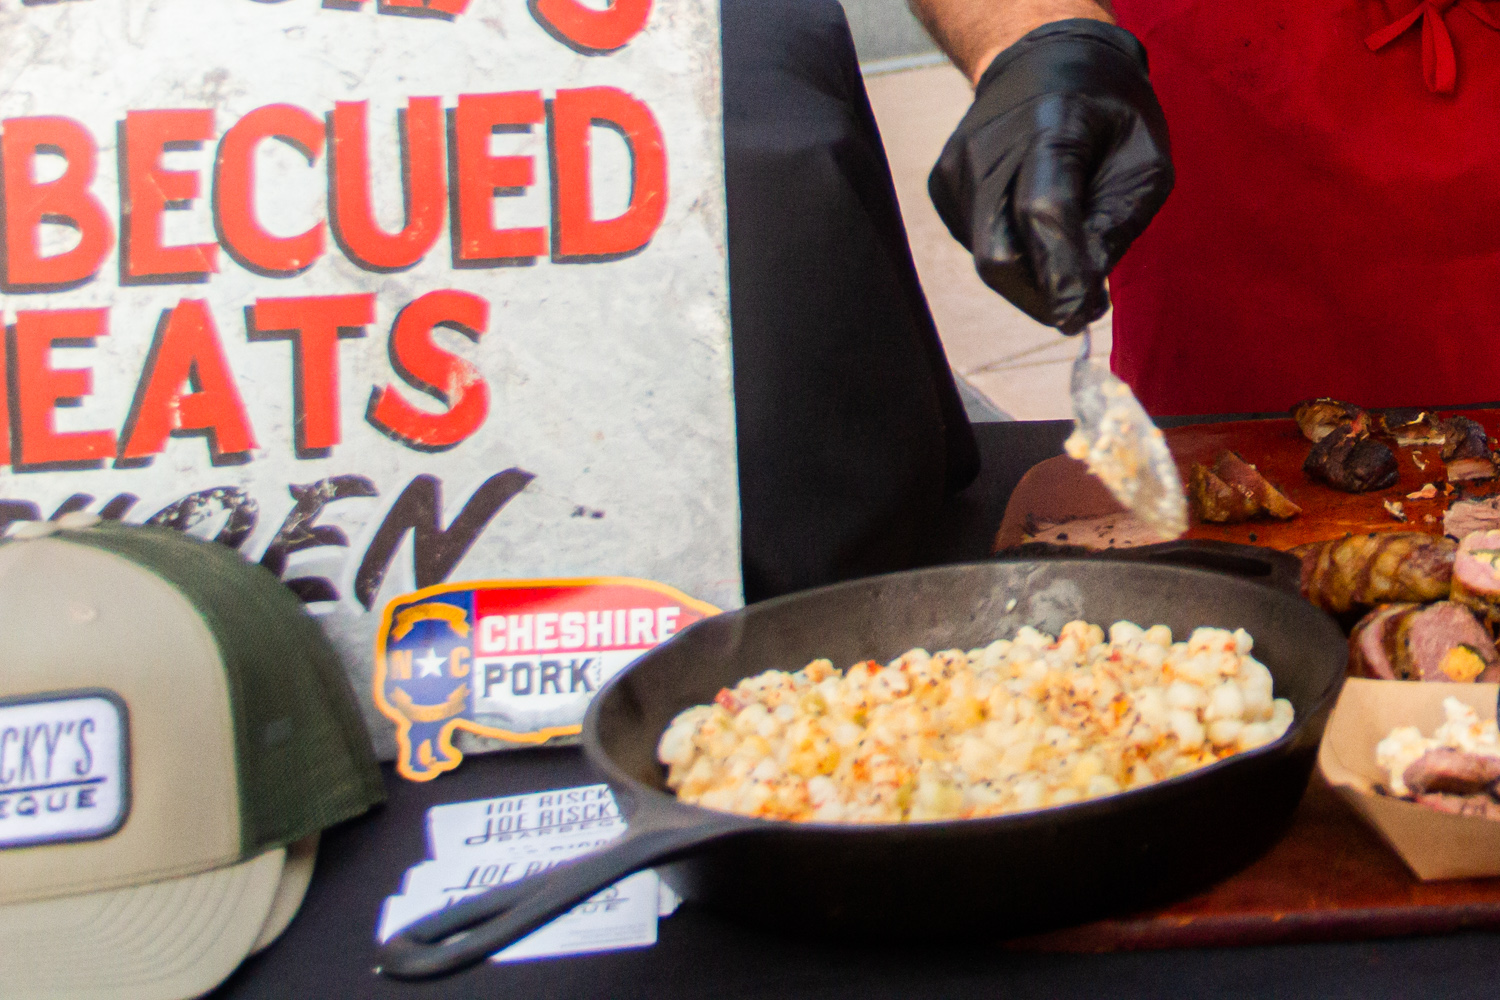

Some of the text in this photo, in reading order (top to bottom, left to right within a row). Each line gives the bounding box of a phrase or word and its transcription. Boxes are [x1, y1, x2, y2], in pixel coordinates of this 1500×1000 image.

[0, 288, 490, 474] EATS
[479, 606, 681, 653] CHESHIRE
[391, 646, 471, 680] N C
[483, 656, 600, 699] PORK
